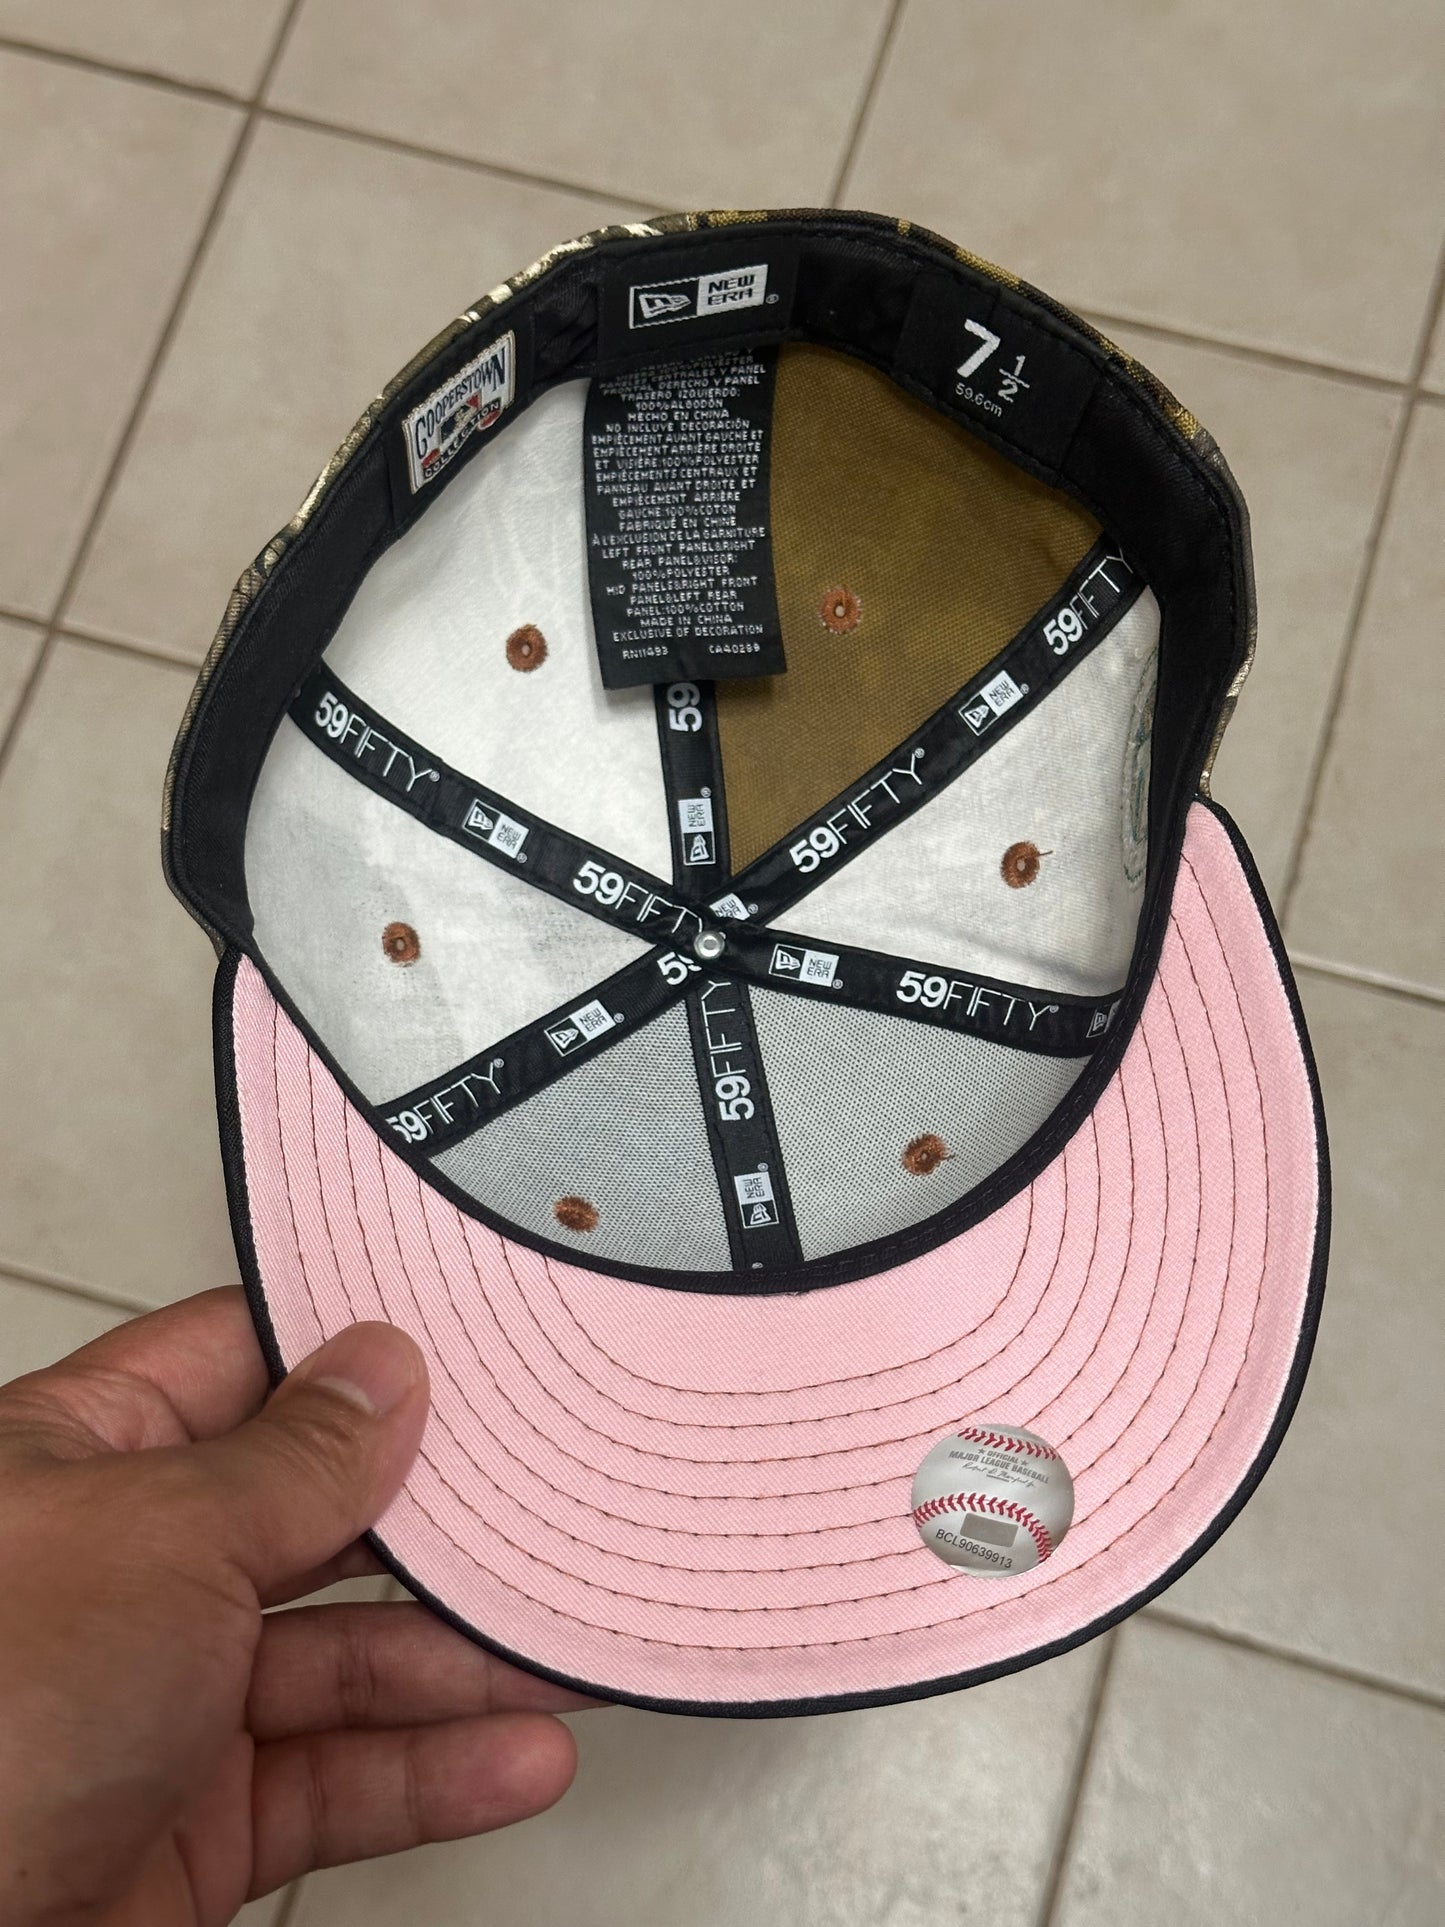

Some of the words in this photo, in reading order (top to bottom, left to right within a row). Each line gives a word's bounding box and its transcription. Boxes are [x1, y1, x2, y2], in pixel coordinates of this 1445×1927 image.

[708, 274, 755, 294] NEW
[708, 288, 752, 306] ERA
[957, 318, 1001, 378] 7
[730, 364, 766, 374] PANEL
[724, 376, 760, 385] PANEL
[621, 391, 672, 402] TRASERO
[955, 382, 1002, 417] 59.6cm
[415, 346, 506, 460] COOPERSTOWN
[628, 411, 668, 422] HECHO
[674, 412, 689, 421] EN
[694, 409, 730, 420] CHINA
[606, 424, 621, 432] NO
[751, 429, 763, 440] ET
[721, 442, 761, 453] DROITE
[595, 460, 609, 470] ET
[743, 466, 757, 477] ET
[695, 479, 735, 490] DROITE
[741, 479, 756, 489] ET
[682, 518, 697, 528] EN
[704, 516, 736, 527] CHINE
[669, 531, 683, 541] DE
[685, 530, 700, 540] LA
[703, 527, 765, 539] GARNITURE
[602, 548, 629, 559] LEFT
[636, 544, 672, 555] FRONT
[622, 558, 652, 570] REAR
[721, 576, 758, 588] FRONT
[708, 590, 737, 600] REAR
[640, 617, 674, 627] MADE
[678, 616, 691, 625] IN
[697, 614, 733, 624] CHINA
[613, 628, 672, 642] EXCLUSIVE
[676, 627, 690, 638] OF
[695, 624, 763, 636] DECORATION
[987, 1450, 1018, 1464] OFFICIAL
[948, 1450, 979, 1463] MAJOR
[980, 1456, 1010, 1470] LEAGUE
[1011, 1463, 1049, 1484] BASEBALL
[935, 1528, 1013, 1568] BCL90639913
